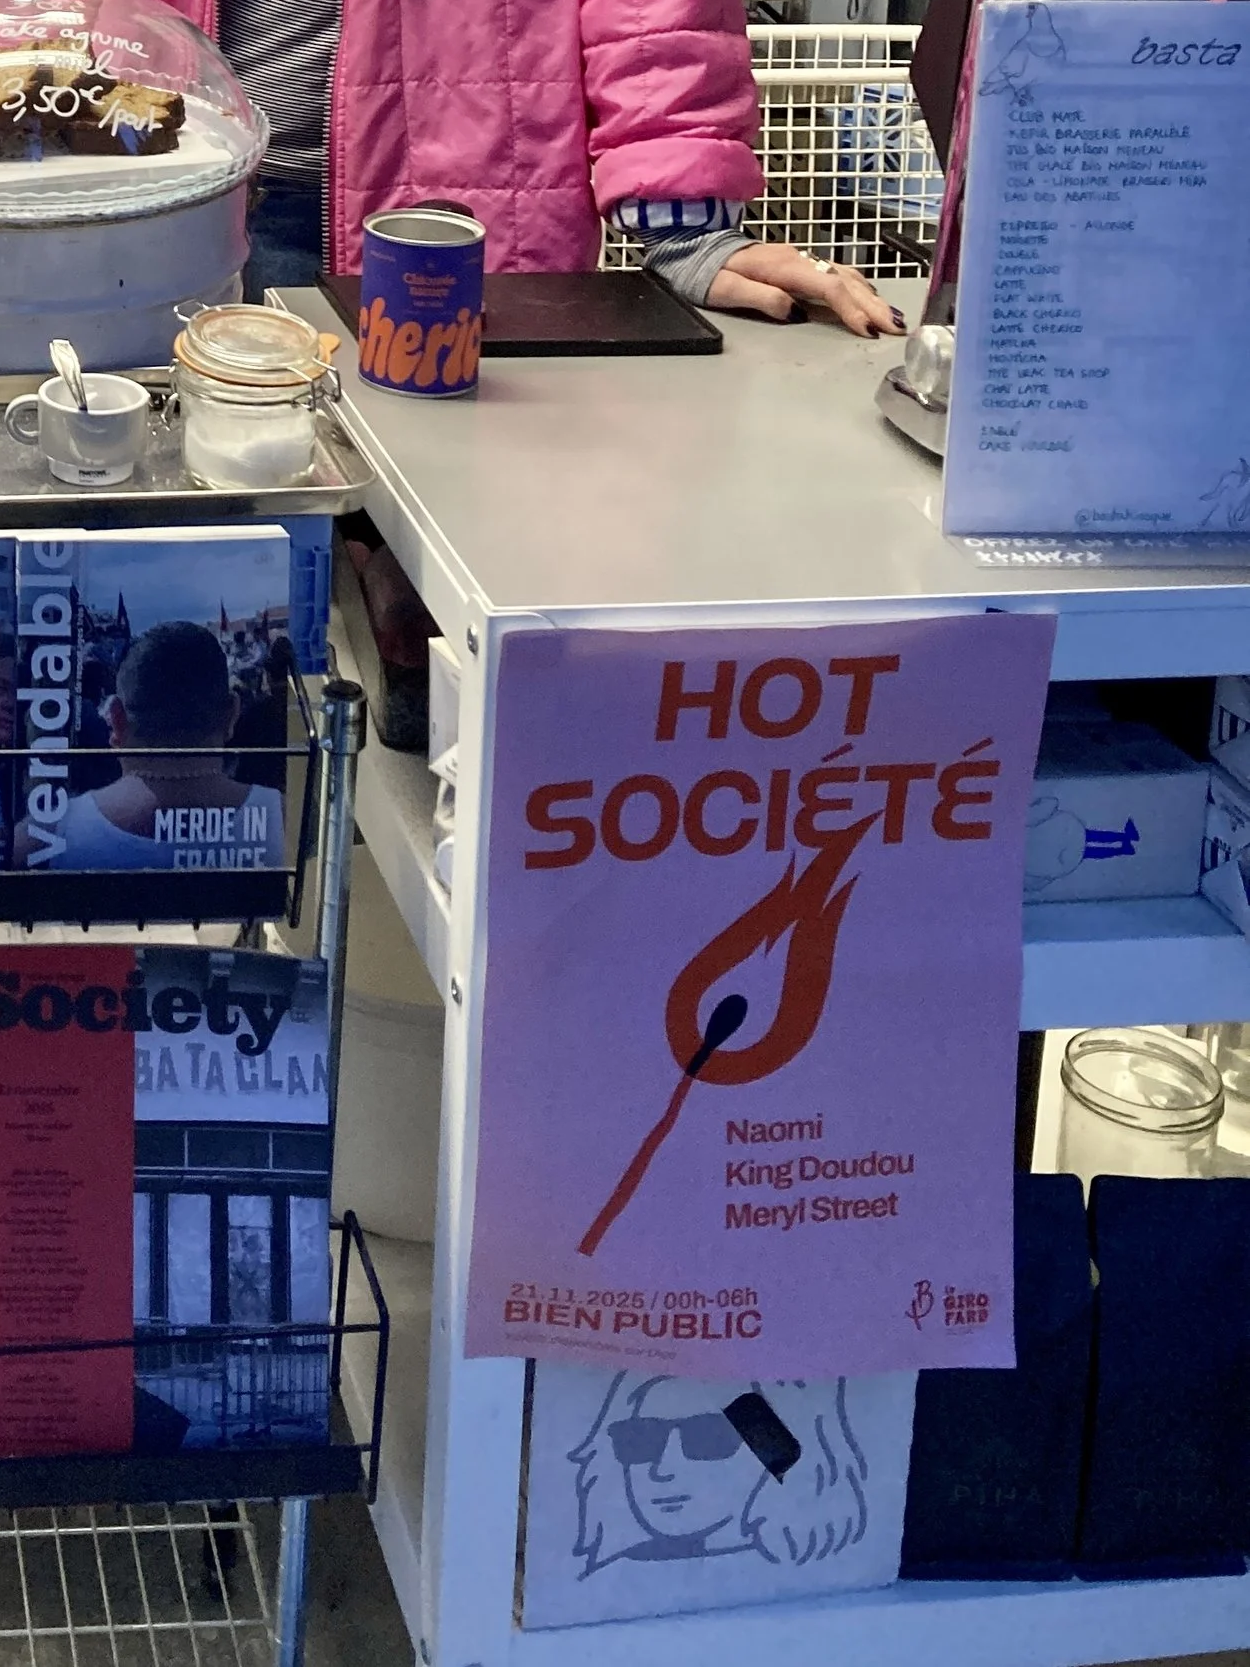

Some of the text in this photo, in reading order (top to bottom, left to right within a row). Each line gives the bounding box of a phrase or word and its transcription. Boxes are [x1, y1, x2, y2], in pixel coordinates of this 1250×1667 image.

[1130, 36, 1243, 67] basta
[654, 653, 901, 742] HOT
[153, 806, 268, 844] MERDE IN
[524, 736, 1002, 872] SOCIÉTÉ
[725, 1112, 824, 1146] Naomi
[724, 1150, 916, 1192] King Doudou
[724, 1190, 900, 1233] Meryl Street
[509, 1282, 646, 1311] 21.11.2025
[663, 1286, 759, 1311] 00h-06h
[503, 1298, 764, 1342] BIEN PUBLIC
